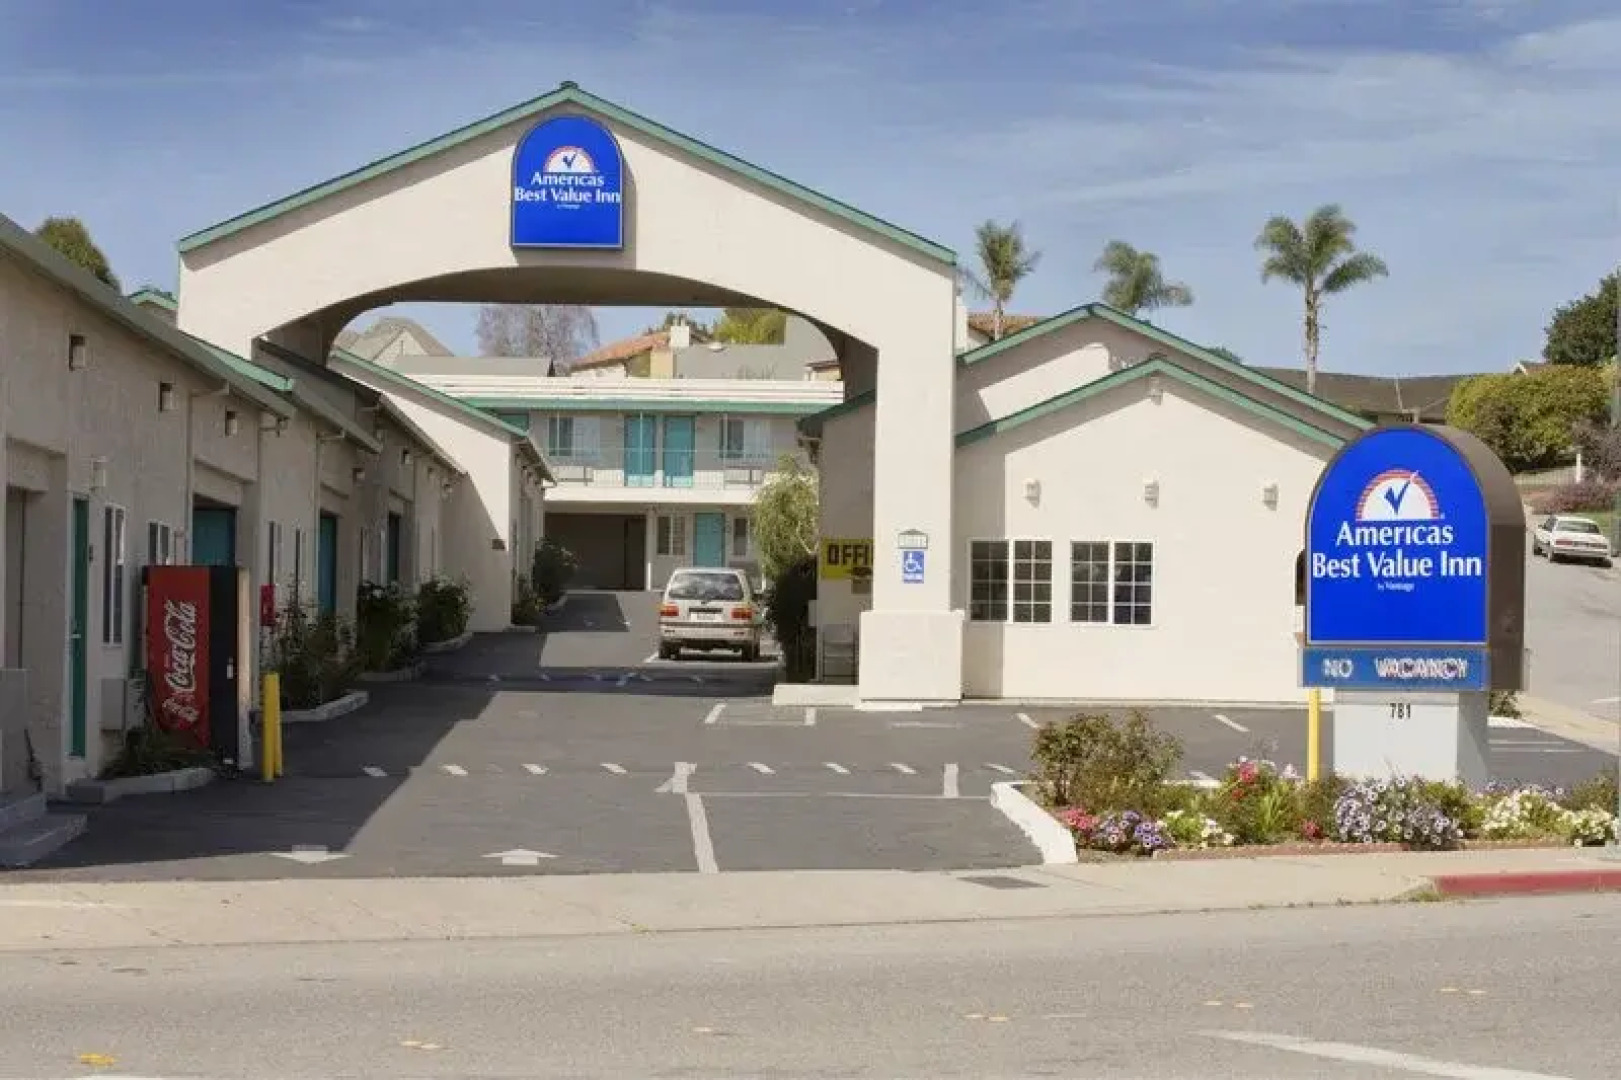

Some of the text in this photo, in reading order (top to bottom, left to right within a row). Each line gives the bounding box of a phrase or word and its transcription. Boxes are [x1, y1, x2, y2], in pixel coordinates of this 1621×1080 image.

[530, 171, 605, 187] Americas
[514, 186, 621, 203] Best Value Inn
[1335, 520, 1454, 547] Americas
[827, 544, 874, 566] OFFI
[1312, 548, 1482, 578] Best Value Inn
[1322, 657, 1468, 679] NO VACANCY
[1389, 702, 1412, 719] 781
